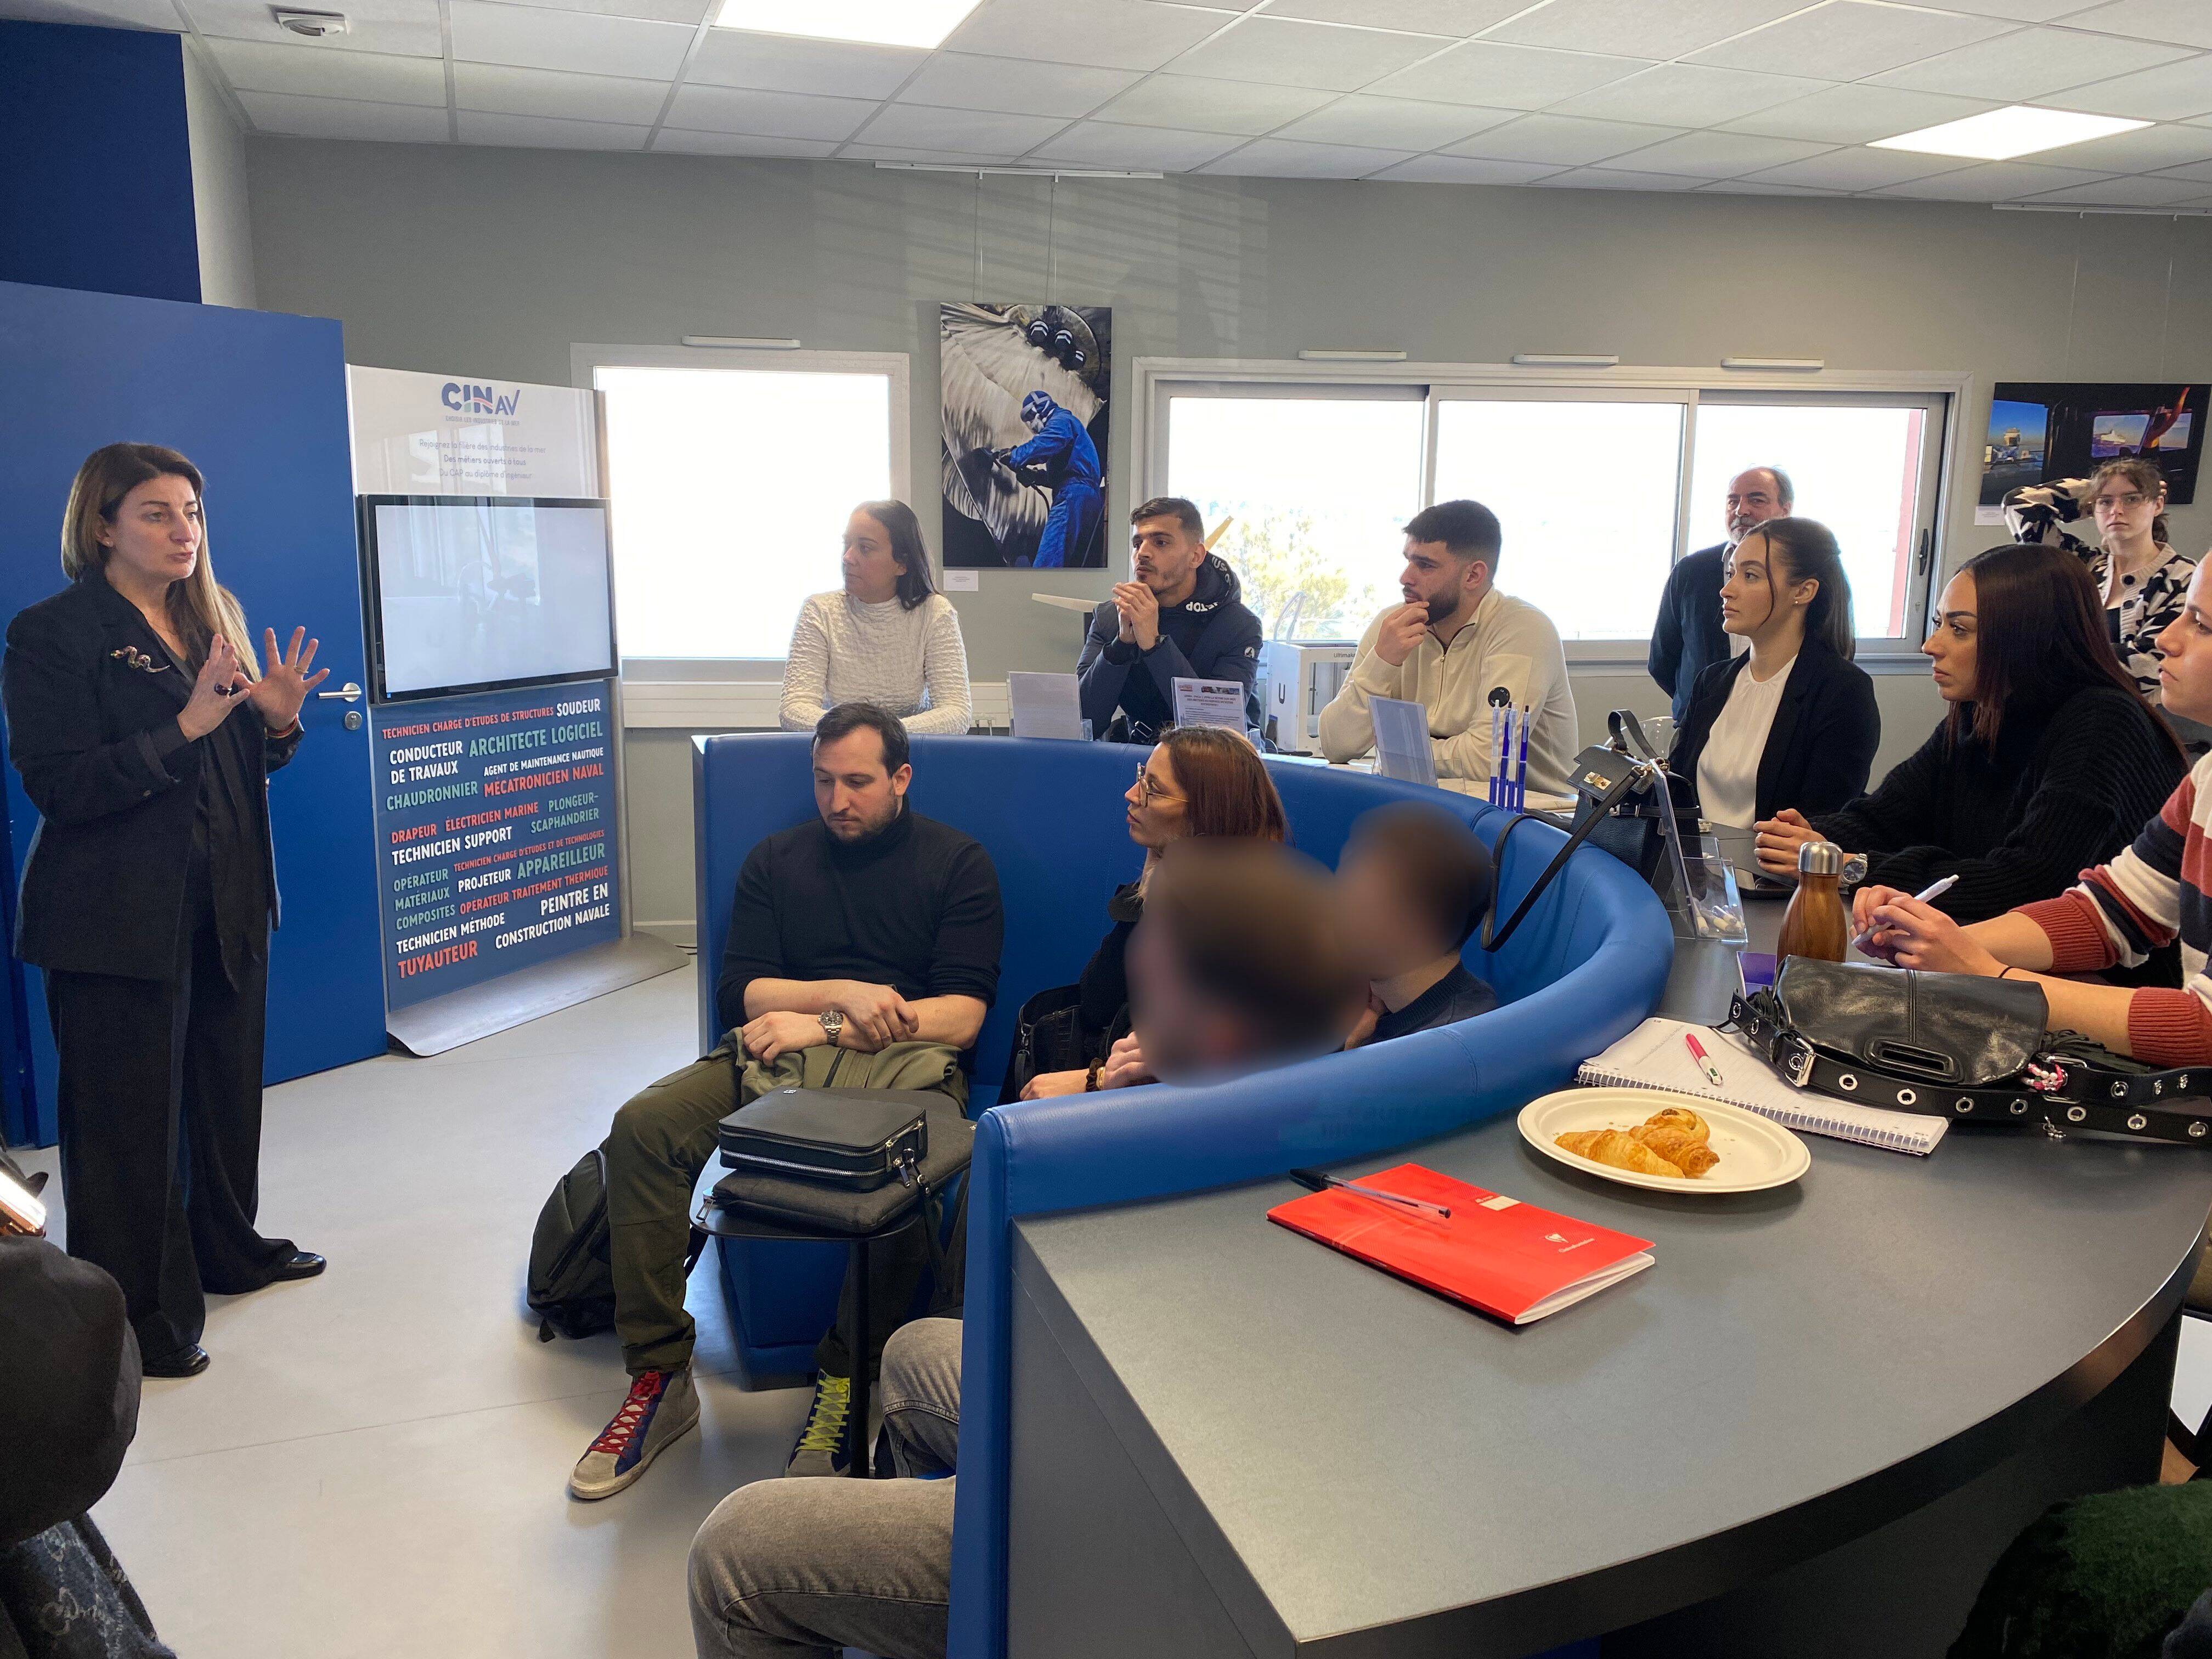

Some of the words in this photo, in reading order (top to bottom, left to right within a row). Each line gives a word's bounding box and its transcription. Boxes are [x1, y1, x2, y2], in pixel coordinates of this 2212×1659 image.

[419, 439, 450, 449] Rejoignez
[459, 441, 476, 449] filière
[490, 444, 517, 452] industries
[444, 454, 456, 462] Des
[458, 455, 482, 464] métiers
[475, 470, 499, 479] diplôme
[556, 698, 601, 717] SOUDEUR
[382, 723, 430, 740] TECHNICIEN
[500, 712, 510, 723] DE
[512, 707, 554, 721] STRUCTURES
[390, 740, 463, 765] CONDUCTEUR
[469, 729, 546, 758] ARCHITECTE
[551, 721, 603, 744] LOGICIEL
[391, 768, 405, 785] DE
[409, 760, 458, 782] TRAVAUX
[483, 763, 507, 777] AGENT
[510, 761, 518, 772] DE
[521, 753, 570, 770] MAINTENANCE
[572, 747, 603, 763] NAUTIQUE
[484, 769, 569, 797] MÉCATRONICIEN
[573, 763, 604, 781] NAVAL
[386, 781, 478, 811] CHAUDRONNIER
[549, 792, 599, 812] PLONGEUR-
[445, 810, 501, 832] ÉLECTRICIEN
[504, 802, 539, 820] MARINE
[531, 808, 600, 834] SCAPHANDRIER
[391, 823, 437, 844] DRAPEUR
[392, 837, 460, 866] TECHNICIEN
[465, 826, 512, 850] SUPPORT
[453, 855, 491, 872] TECHNICIEN
[548, 840, 554, 850] ET
[556, 838, 563, 847] DE
[565, 829, 605, 846] TECHNOLOGIES
[517, 843, 605, 879] APPAREILLEUR
[393, 868, 448, 891] OPÉRATEUR
[458, 868, 511, 893] PROJETEUR
[511, 878, 562, 901] TRAITEMENT
[564, 865, 608, 885] THERMIQUE
[395, 887, 450, 911] MATÉRIAUX
[540, 888, 589, 916] PEINTRE
[593, 882, 608, 901] EN
[396, 904, 455, 930] COMPOSITES
[495, 915, 571, 949] CONSTRUCTION
[575, 903, 610, 926] NAVALE
[396, 926, 457, 954] TECHNICIEN
[460, 912, 505, 936] MÉTHODE
[398, 940, 478, 979] TUYAUTEUR
